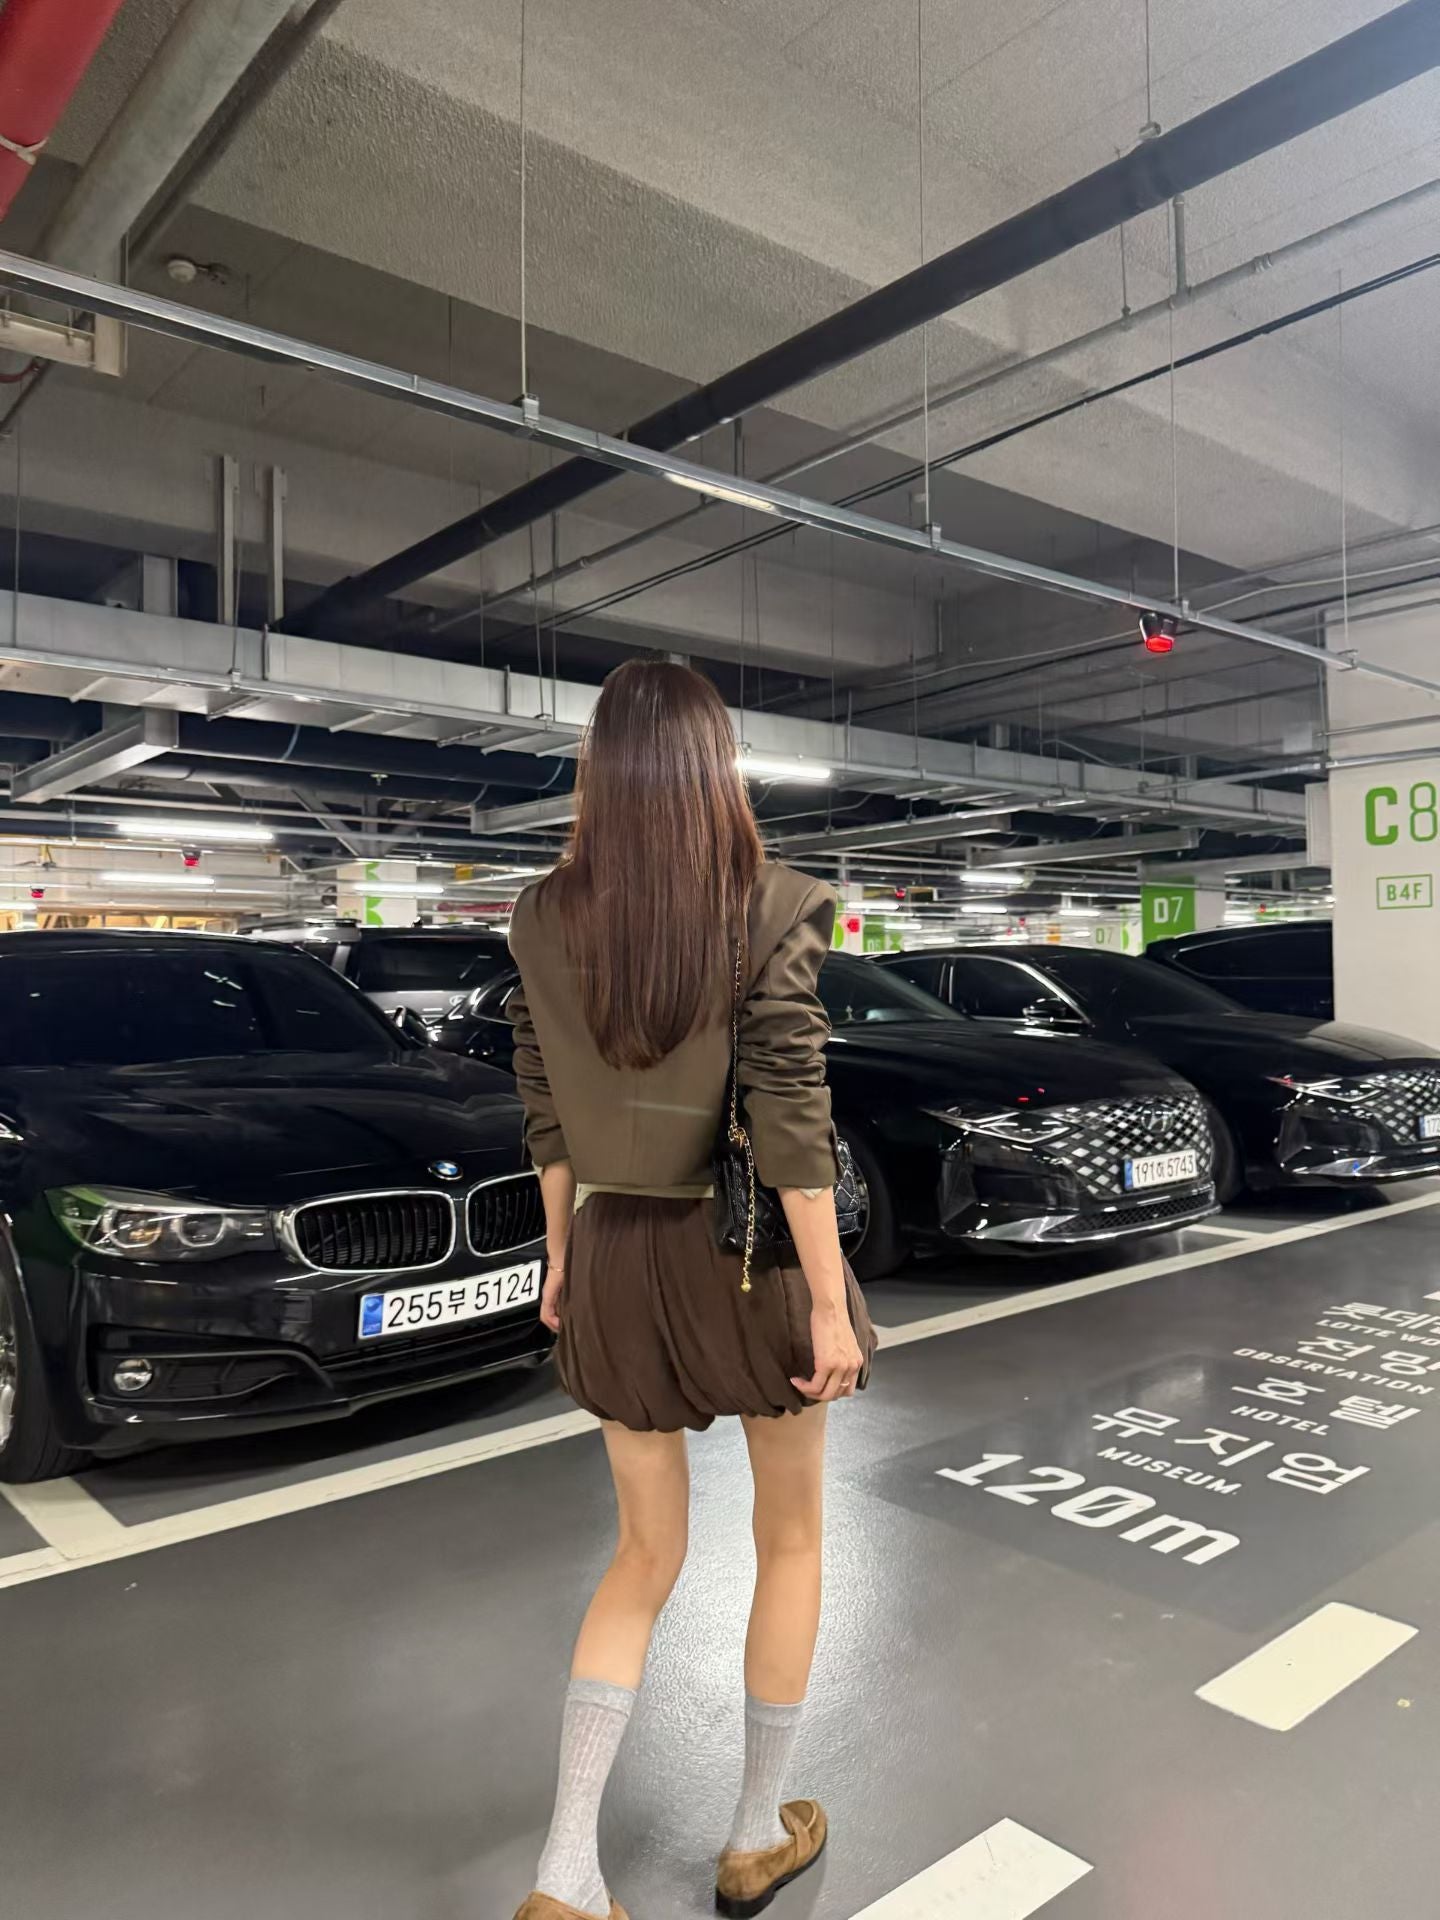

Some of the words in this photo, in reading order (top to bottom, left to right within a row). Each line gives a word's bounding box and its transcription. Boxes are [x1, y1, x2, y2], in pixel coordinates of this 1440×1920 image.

[1365, 781, 1438, 846] C8
[1153, 896, 1184, 924] D7
[1386, 882, 1423, 902] B4F
[1167, 1154, 1194, 1177] 5743
[387, 1287, 466, 1328] 255부
[474, 1269, 534, 1311] 5124
[1315, 1319, 1396, 1338] LOTTE
[1233, 1348, 1435, 1395] OBSERVATION
[1230, 1406, 1330, 1436] HOTEL
[1096, 1447, 1242, 1495] MUSEUM
[934, 1453, 1240, 1565] 120m
